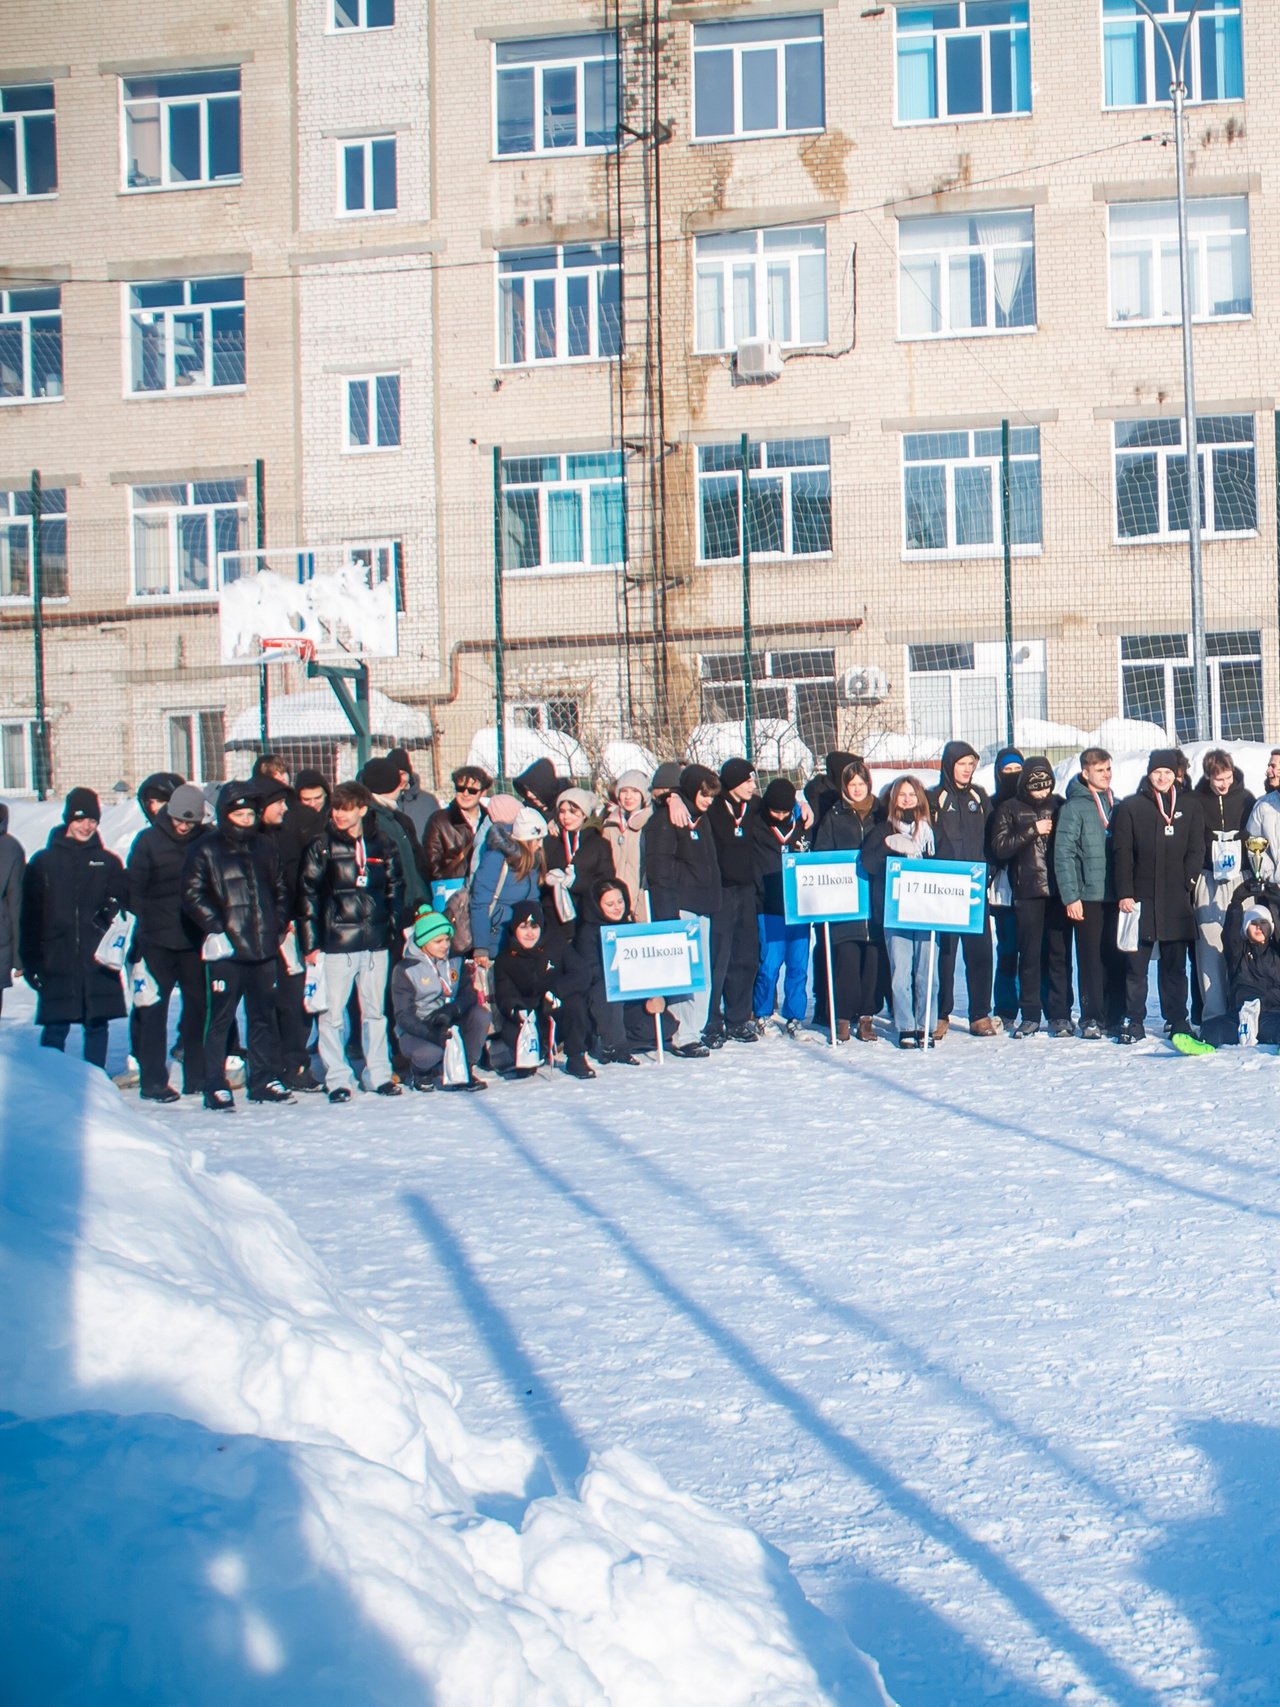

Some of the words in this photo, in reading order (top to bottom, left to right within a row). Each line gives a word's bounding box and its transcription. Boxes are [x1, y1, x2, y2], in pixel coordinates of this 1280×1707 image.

[801, 875, 815, 888] 22
[817, 872, 854, 887] Школа
[906, 882, 920, 895] 17
[923, 883, 965, 897] Школа
[623, 948, 639, 961] 20
[641, 944, 685, 959] Школа
[212, 980, 226, 992] 10
